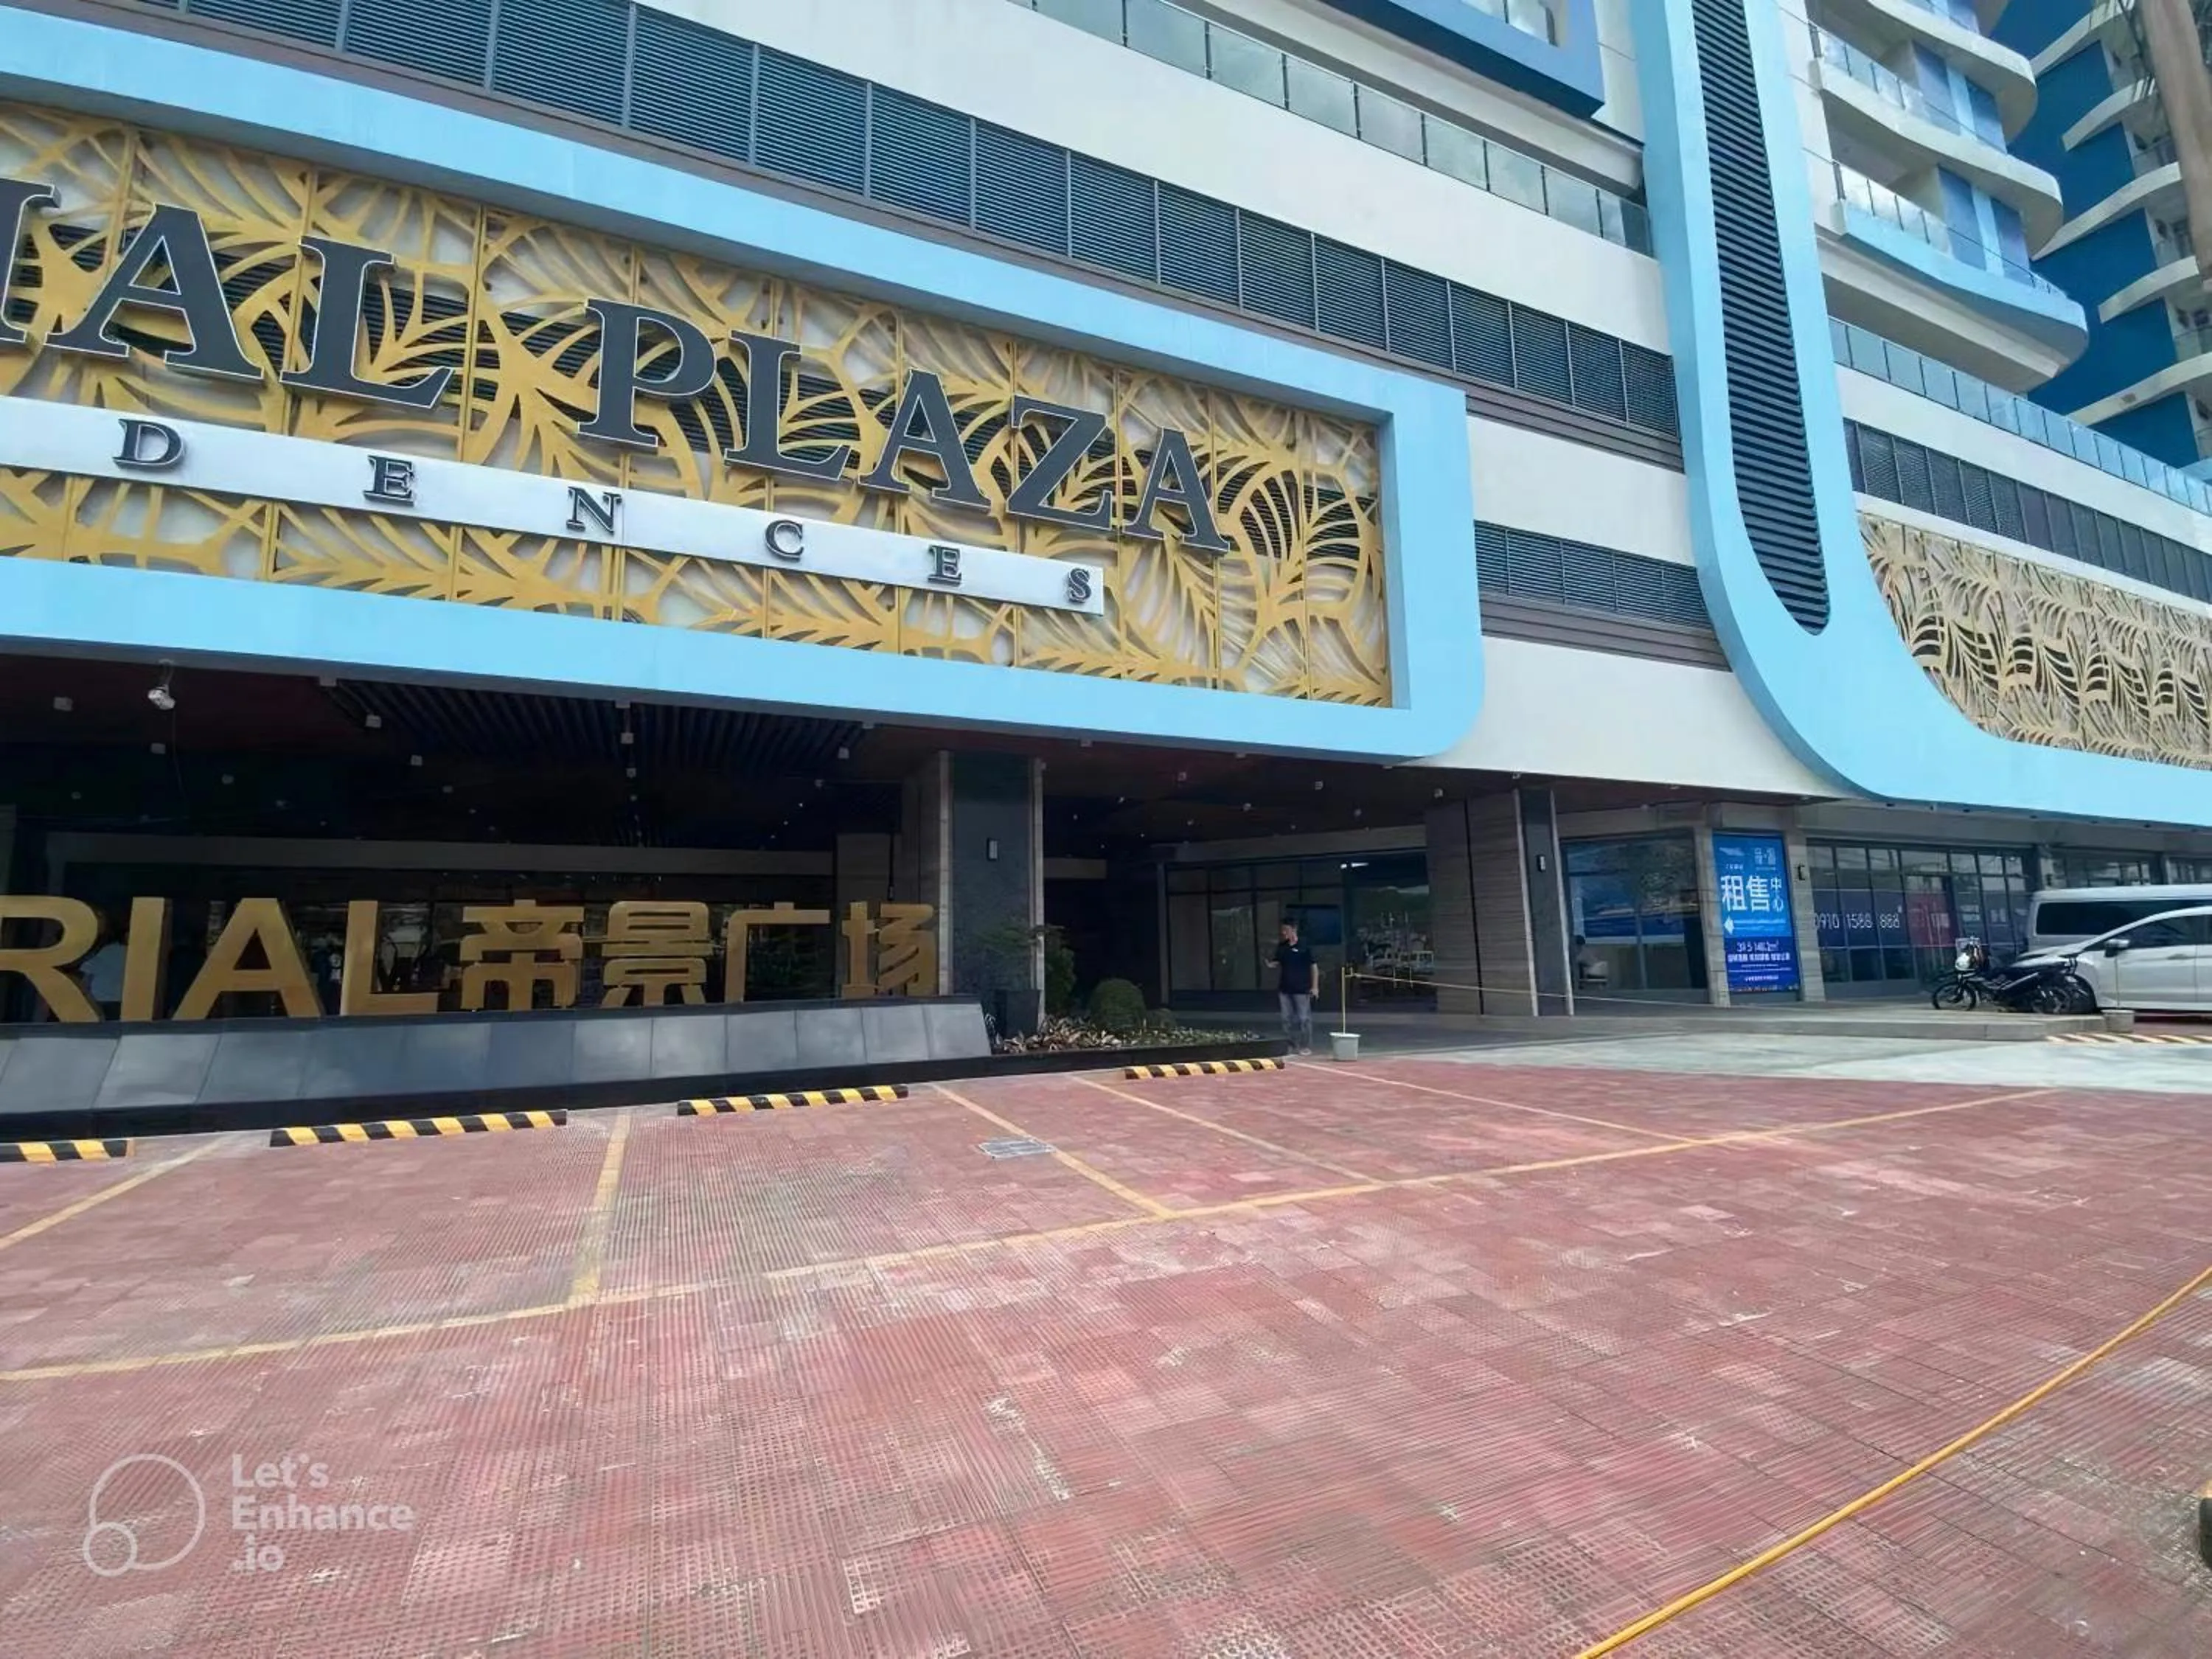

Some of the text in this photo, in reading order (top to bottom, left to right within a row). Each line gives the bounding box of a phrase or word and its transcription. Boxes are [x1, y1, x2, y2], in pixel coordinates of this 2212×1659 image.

[578, 298, 1230, 553] PLAZA
[0, 894, 439, 1022] RIAL
[460, 899, 937, 1012] 帝景广场
